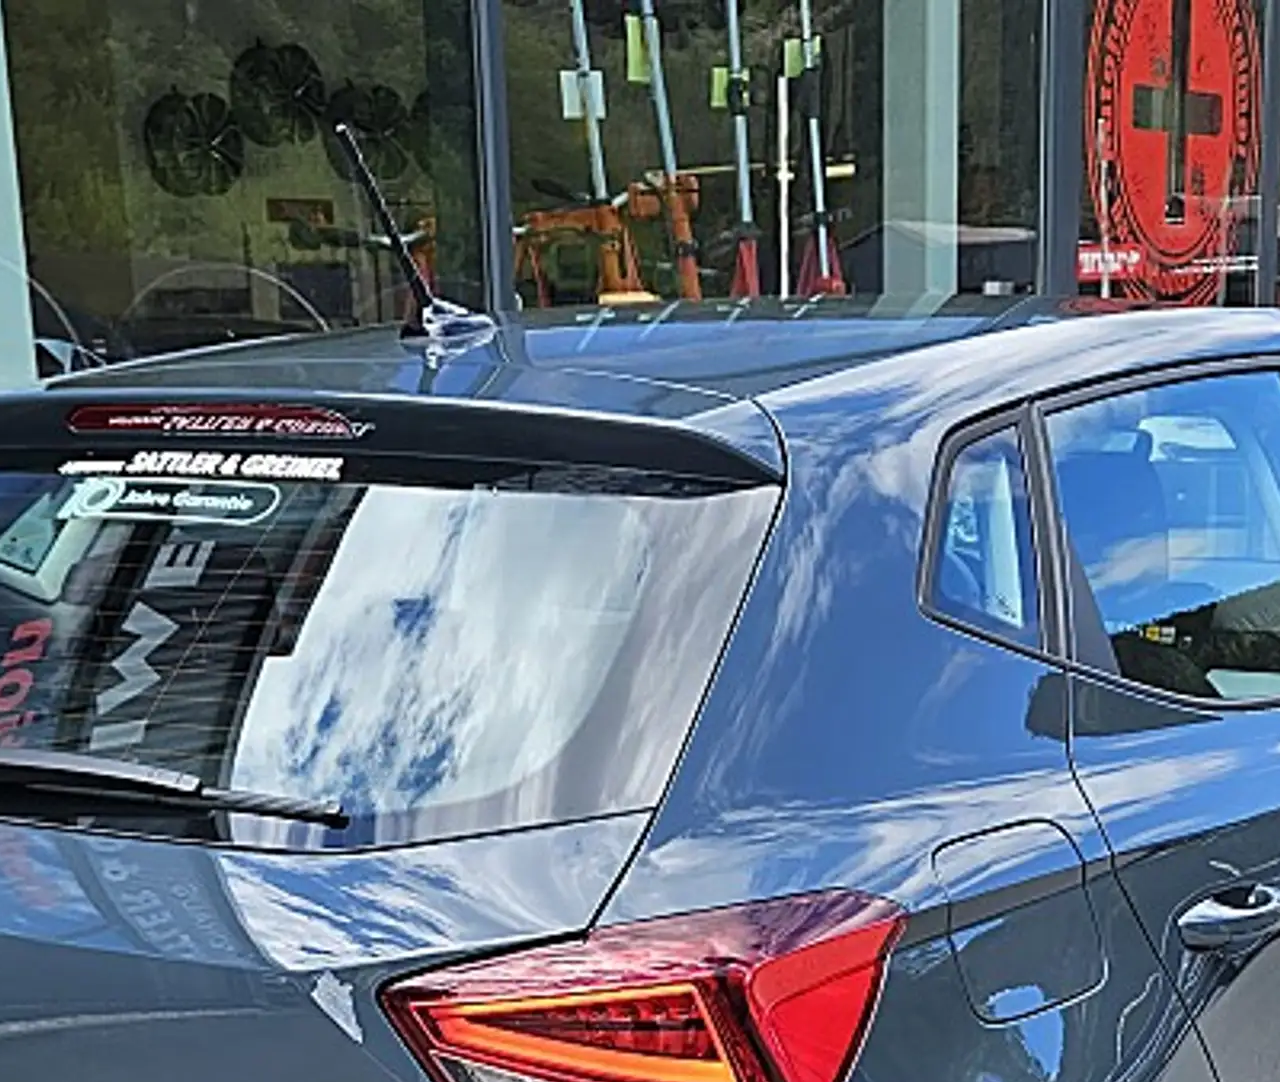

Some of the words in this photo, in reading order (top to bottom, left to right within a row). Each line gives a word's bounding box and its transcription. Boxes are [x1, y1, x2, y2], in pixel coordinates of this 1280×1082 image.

[125, 451, 224, 475] SATTLER
[219, 454, 241, 475] &
[240, 454, 344, 480] GREIMEL
